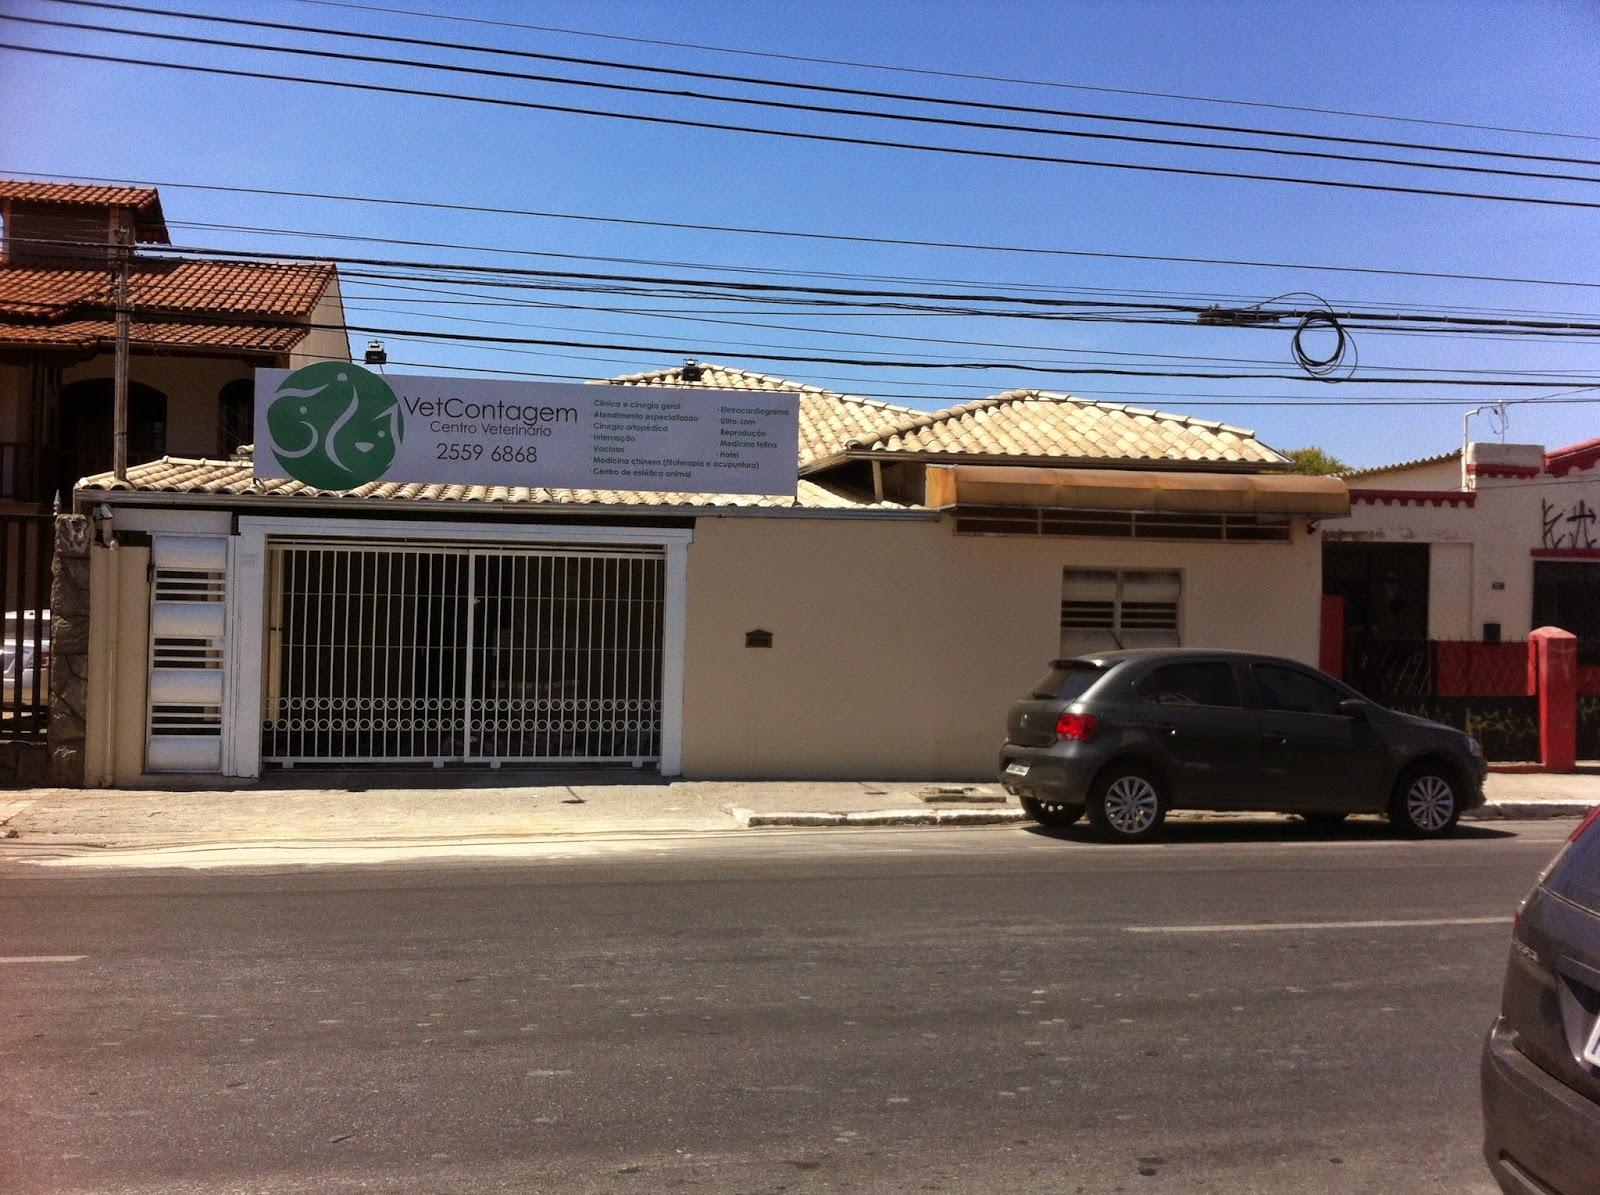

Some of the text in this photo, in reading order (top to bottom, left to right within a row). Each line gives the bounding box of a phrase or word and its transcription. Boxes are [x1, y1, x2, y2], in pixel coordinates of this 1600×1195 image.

[404, 396, 577, 426] VetContagem
[630, 401, 659, 410] cirurgia
[660, 402, 681, 411] geral
[720, 406, 790, 416] Eletrocardiograma
[593, 411, 699, 423] Atendimento especializado
[430, 420, 552, 437] Centro Veterinário
[593, 422, 624, 431] Cirurgia
[720, 429, 767, 437] Reprodução
[593, 434, 636, 443] Internação
[593, 445, 625, 453] Vacinas
[720, 440, 777, 449] Medicina felina
[436, 443, 537, 463] 2559 6868
[593, 456, 629, 465] Medicina
[631, 457, 661, 466] chinesa
[592, 467, 619, 476] Centro
[620, 468, 631, 476] de
[665, 470, 692, 478] animal
